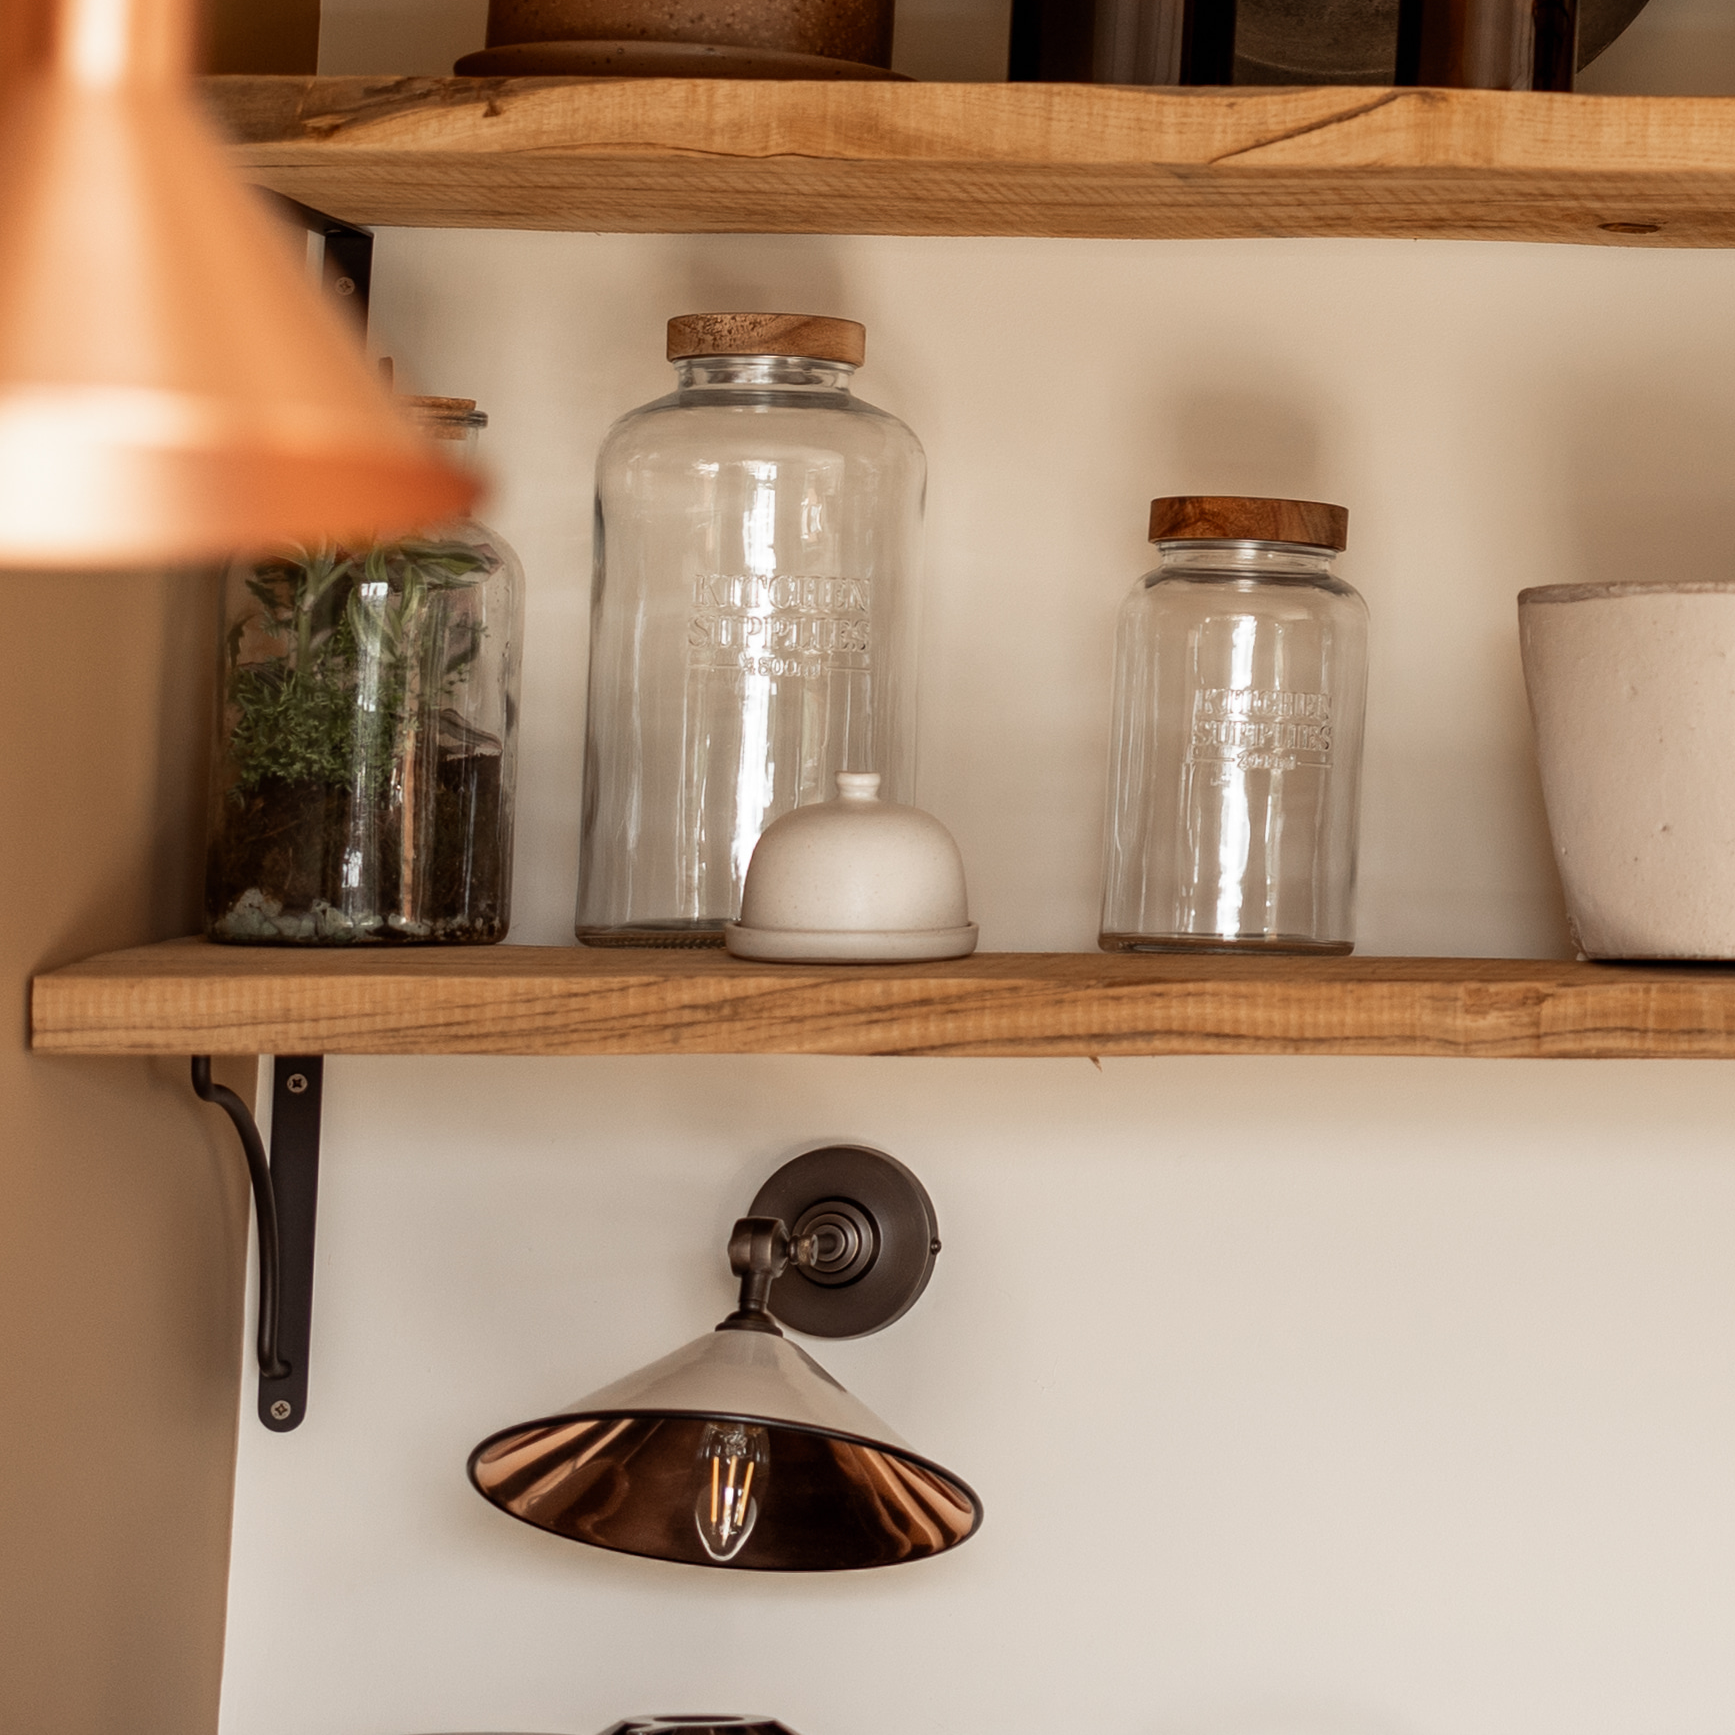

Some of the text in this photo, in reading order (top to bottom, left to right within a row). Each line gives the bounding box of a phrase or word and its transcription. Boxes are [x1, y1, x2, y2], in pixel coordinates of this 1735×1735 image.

[693, 574, 870, 611] KITCHEN
[688, 616, 870, 652] SUPPLIES
[1195, 689, 1333, 720] KITCHEN
[1193, 721, 1333, 752] SUPPLIES
